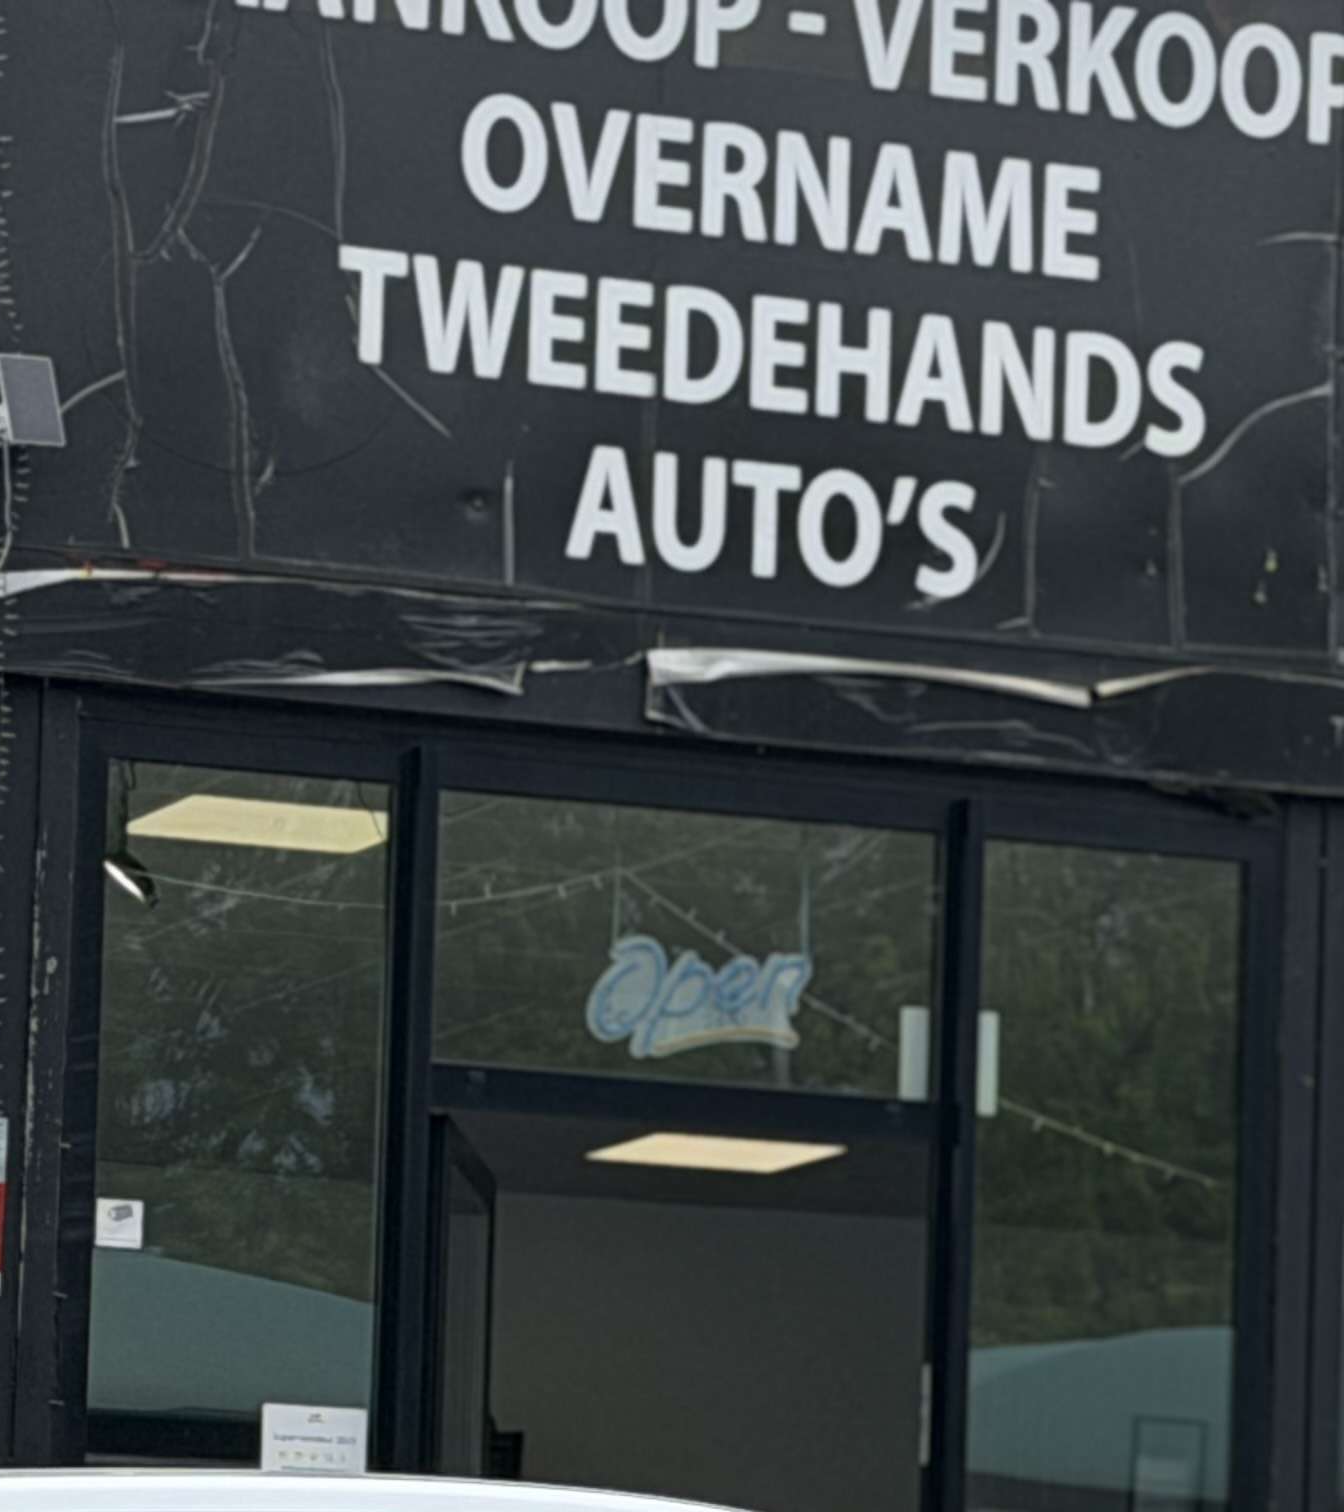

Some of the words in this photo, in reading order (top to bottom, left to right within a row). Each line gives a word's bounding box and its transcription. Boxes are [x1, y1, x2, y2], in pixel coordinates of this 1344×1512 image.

[460, 92, 1102, 283] OVERNAME
[339, 243, 1207, 460] TWEEDEHANDS
[564, 443, 980, 601] AUTO'S
[587, 935, 811, 1059] Open
